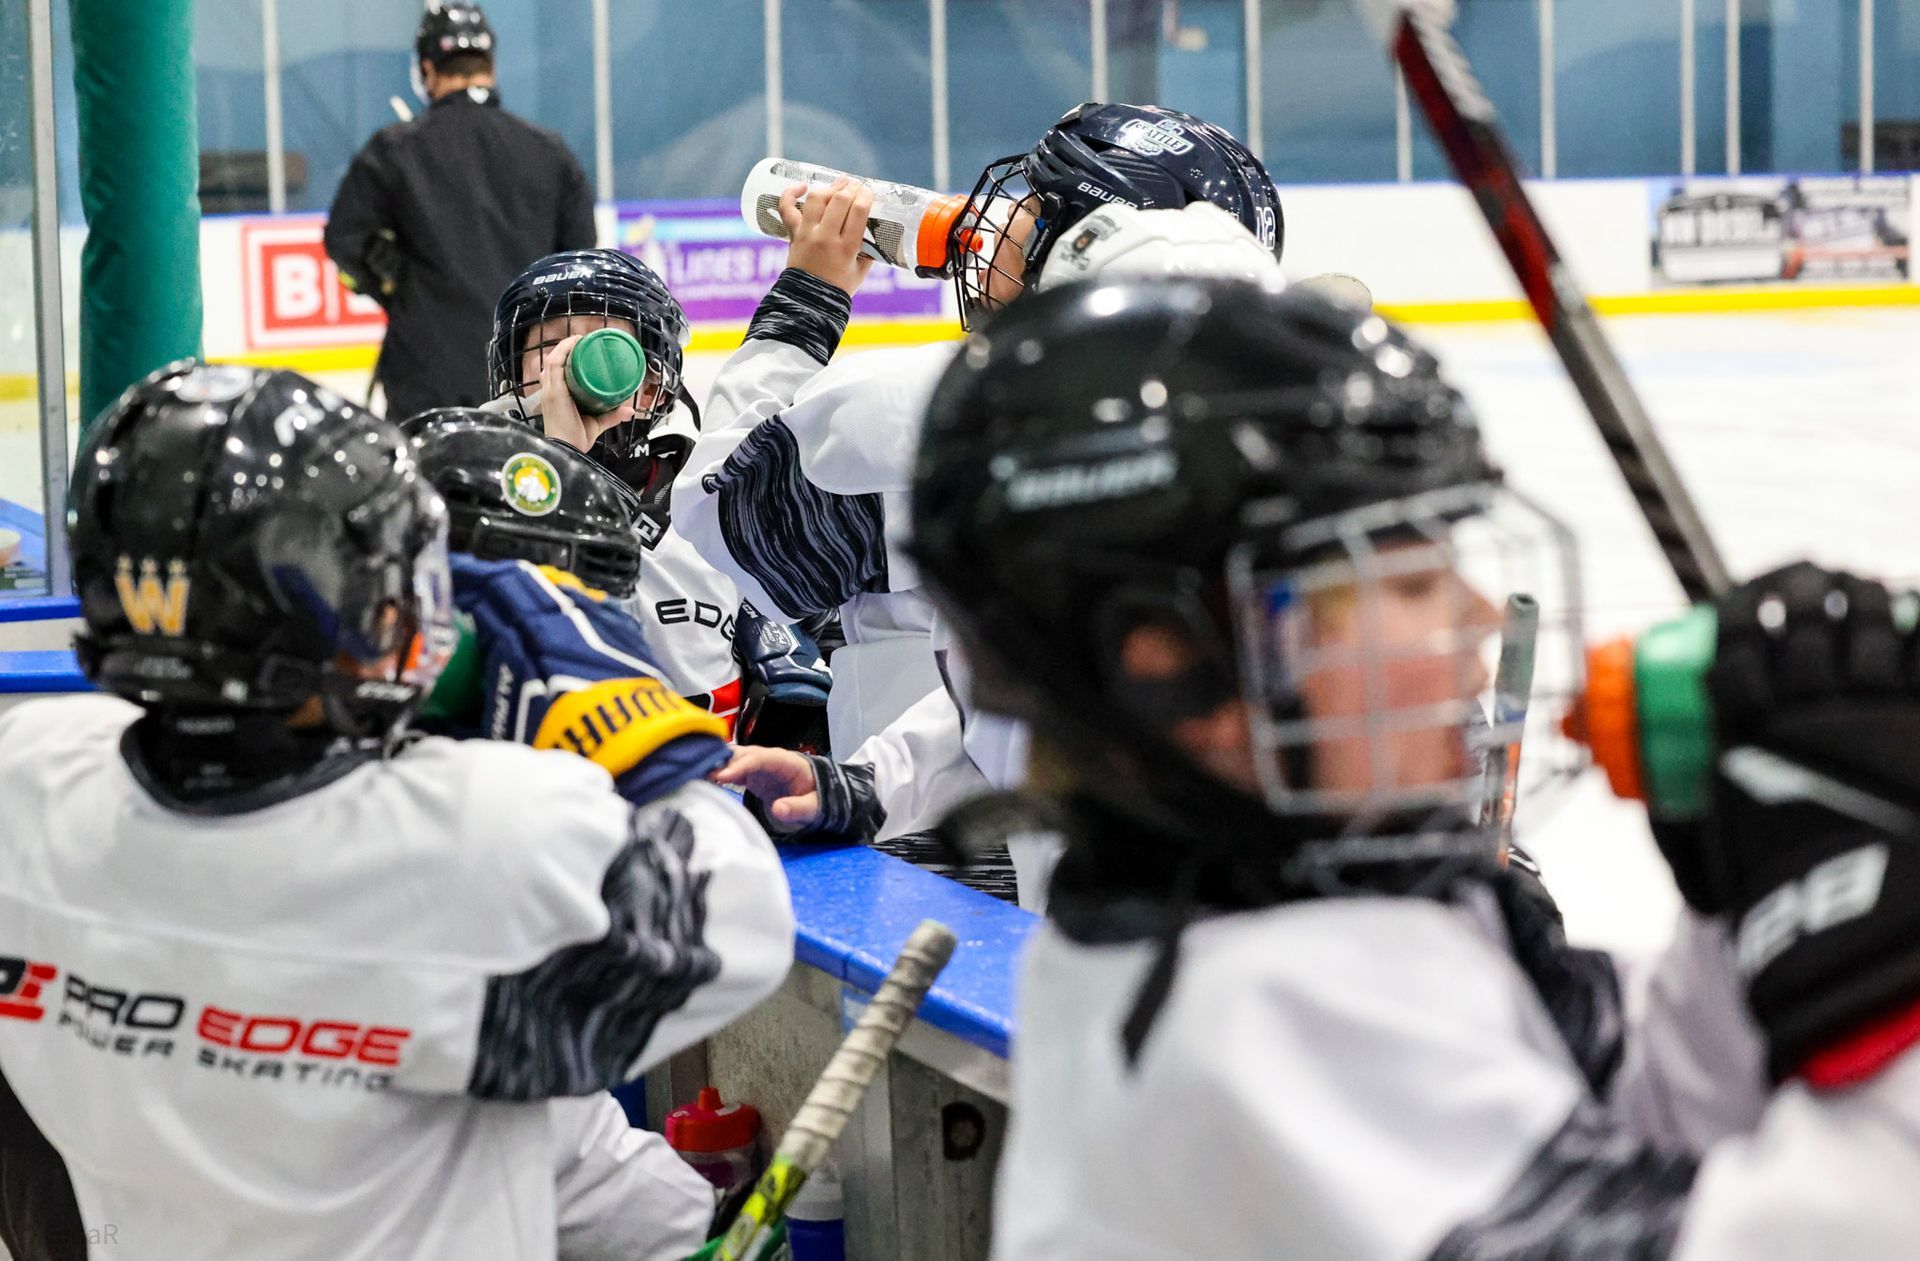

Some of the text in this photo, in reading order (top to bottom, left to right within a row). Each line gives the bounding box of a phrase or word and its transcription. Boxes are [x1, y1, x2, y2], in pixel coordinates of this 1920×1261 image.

[655, 598, 736, 642] EDG
[65, 972, 186, 1030] PRO
[197, 1005, 411, 1066] EDGE
